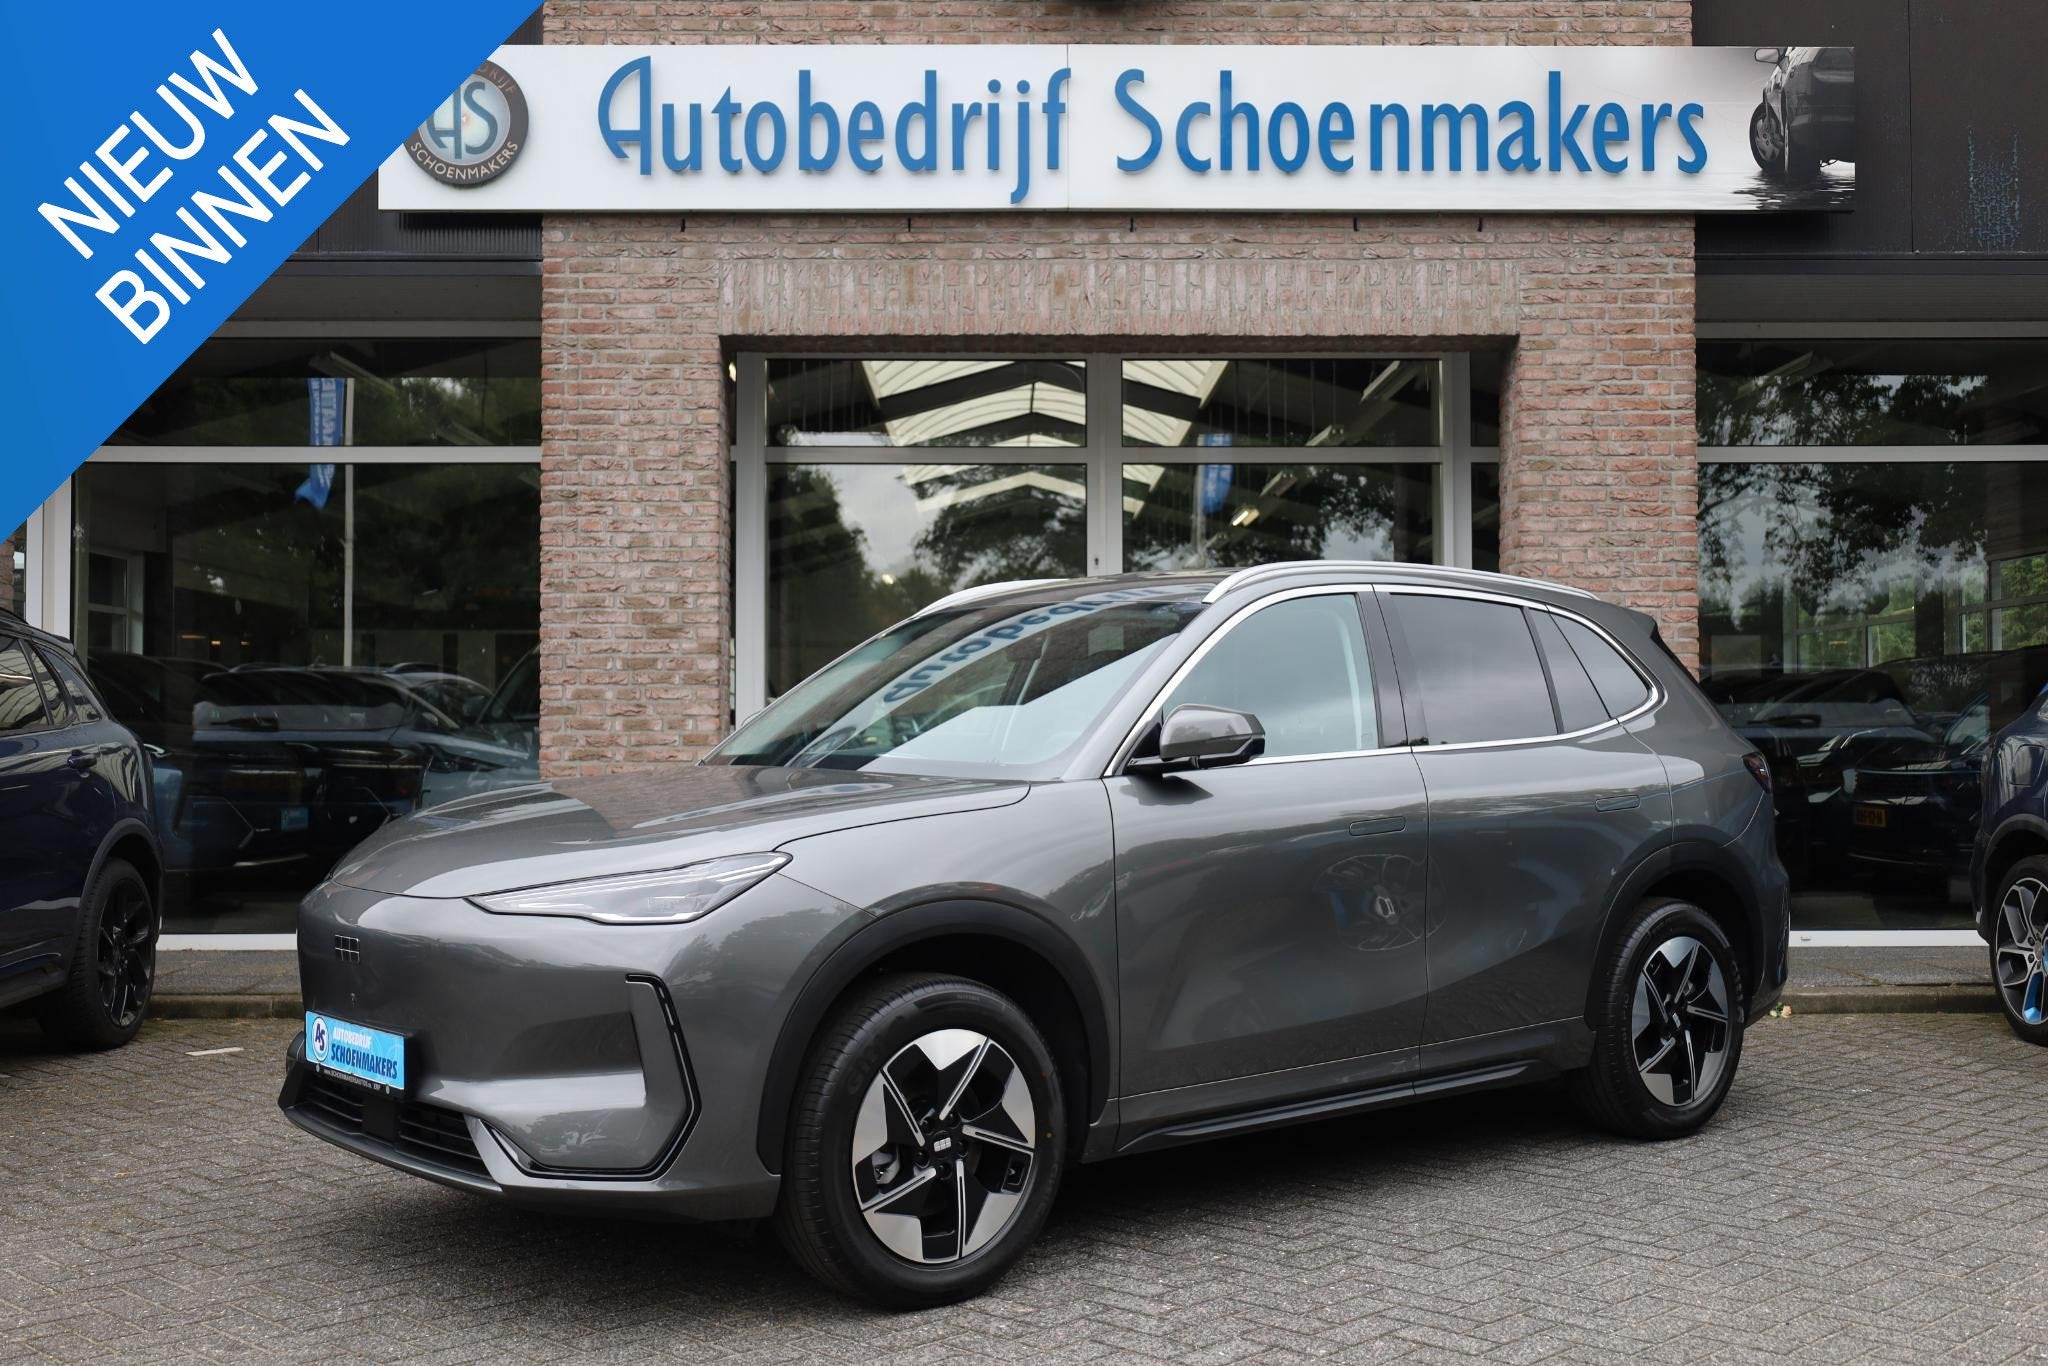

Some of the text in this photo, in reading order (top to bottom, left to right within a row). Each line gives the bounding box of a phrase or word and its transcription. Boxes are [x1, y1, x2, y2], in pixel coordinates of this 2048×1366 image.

[598, 57, 1708, 204] Autobedrijf Schoenmakers
[411, 141, 518, 180] SCHOENMAKERS
[331, 1043, 398, 1079] SCHOENMAKERS
